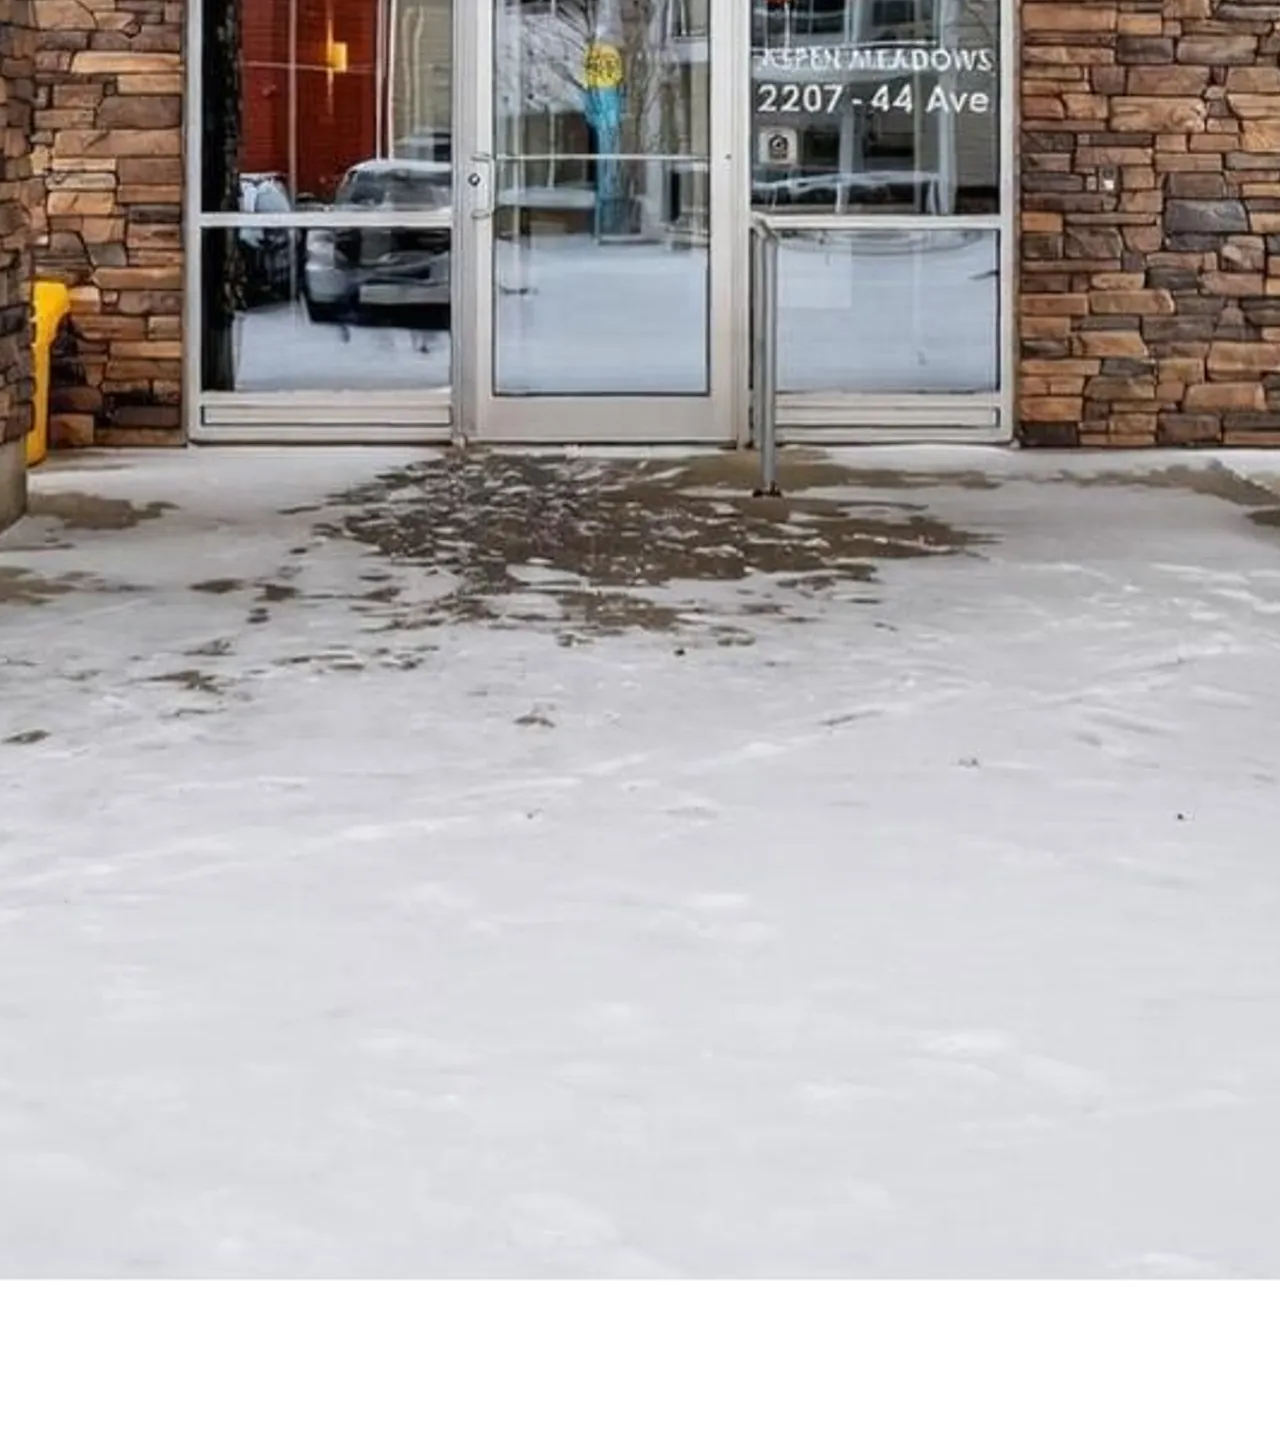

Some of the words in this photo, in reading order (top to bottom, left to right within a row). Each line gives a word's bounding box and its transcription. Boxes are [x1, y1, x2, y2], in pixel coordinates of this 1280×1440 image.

[757, 84, 842, 112] 2207
[871, 85, 913, 112] 44
[926, 84, 990, 112] Ave
